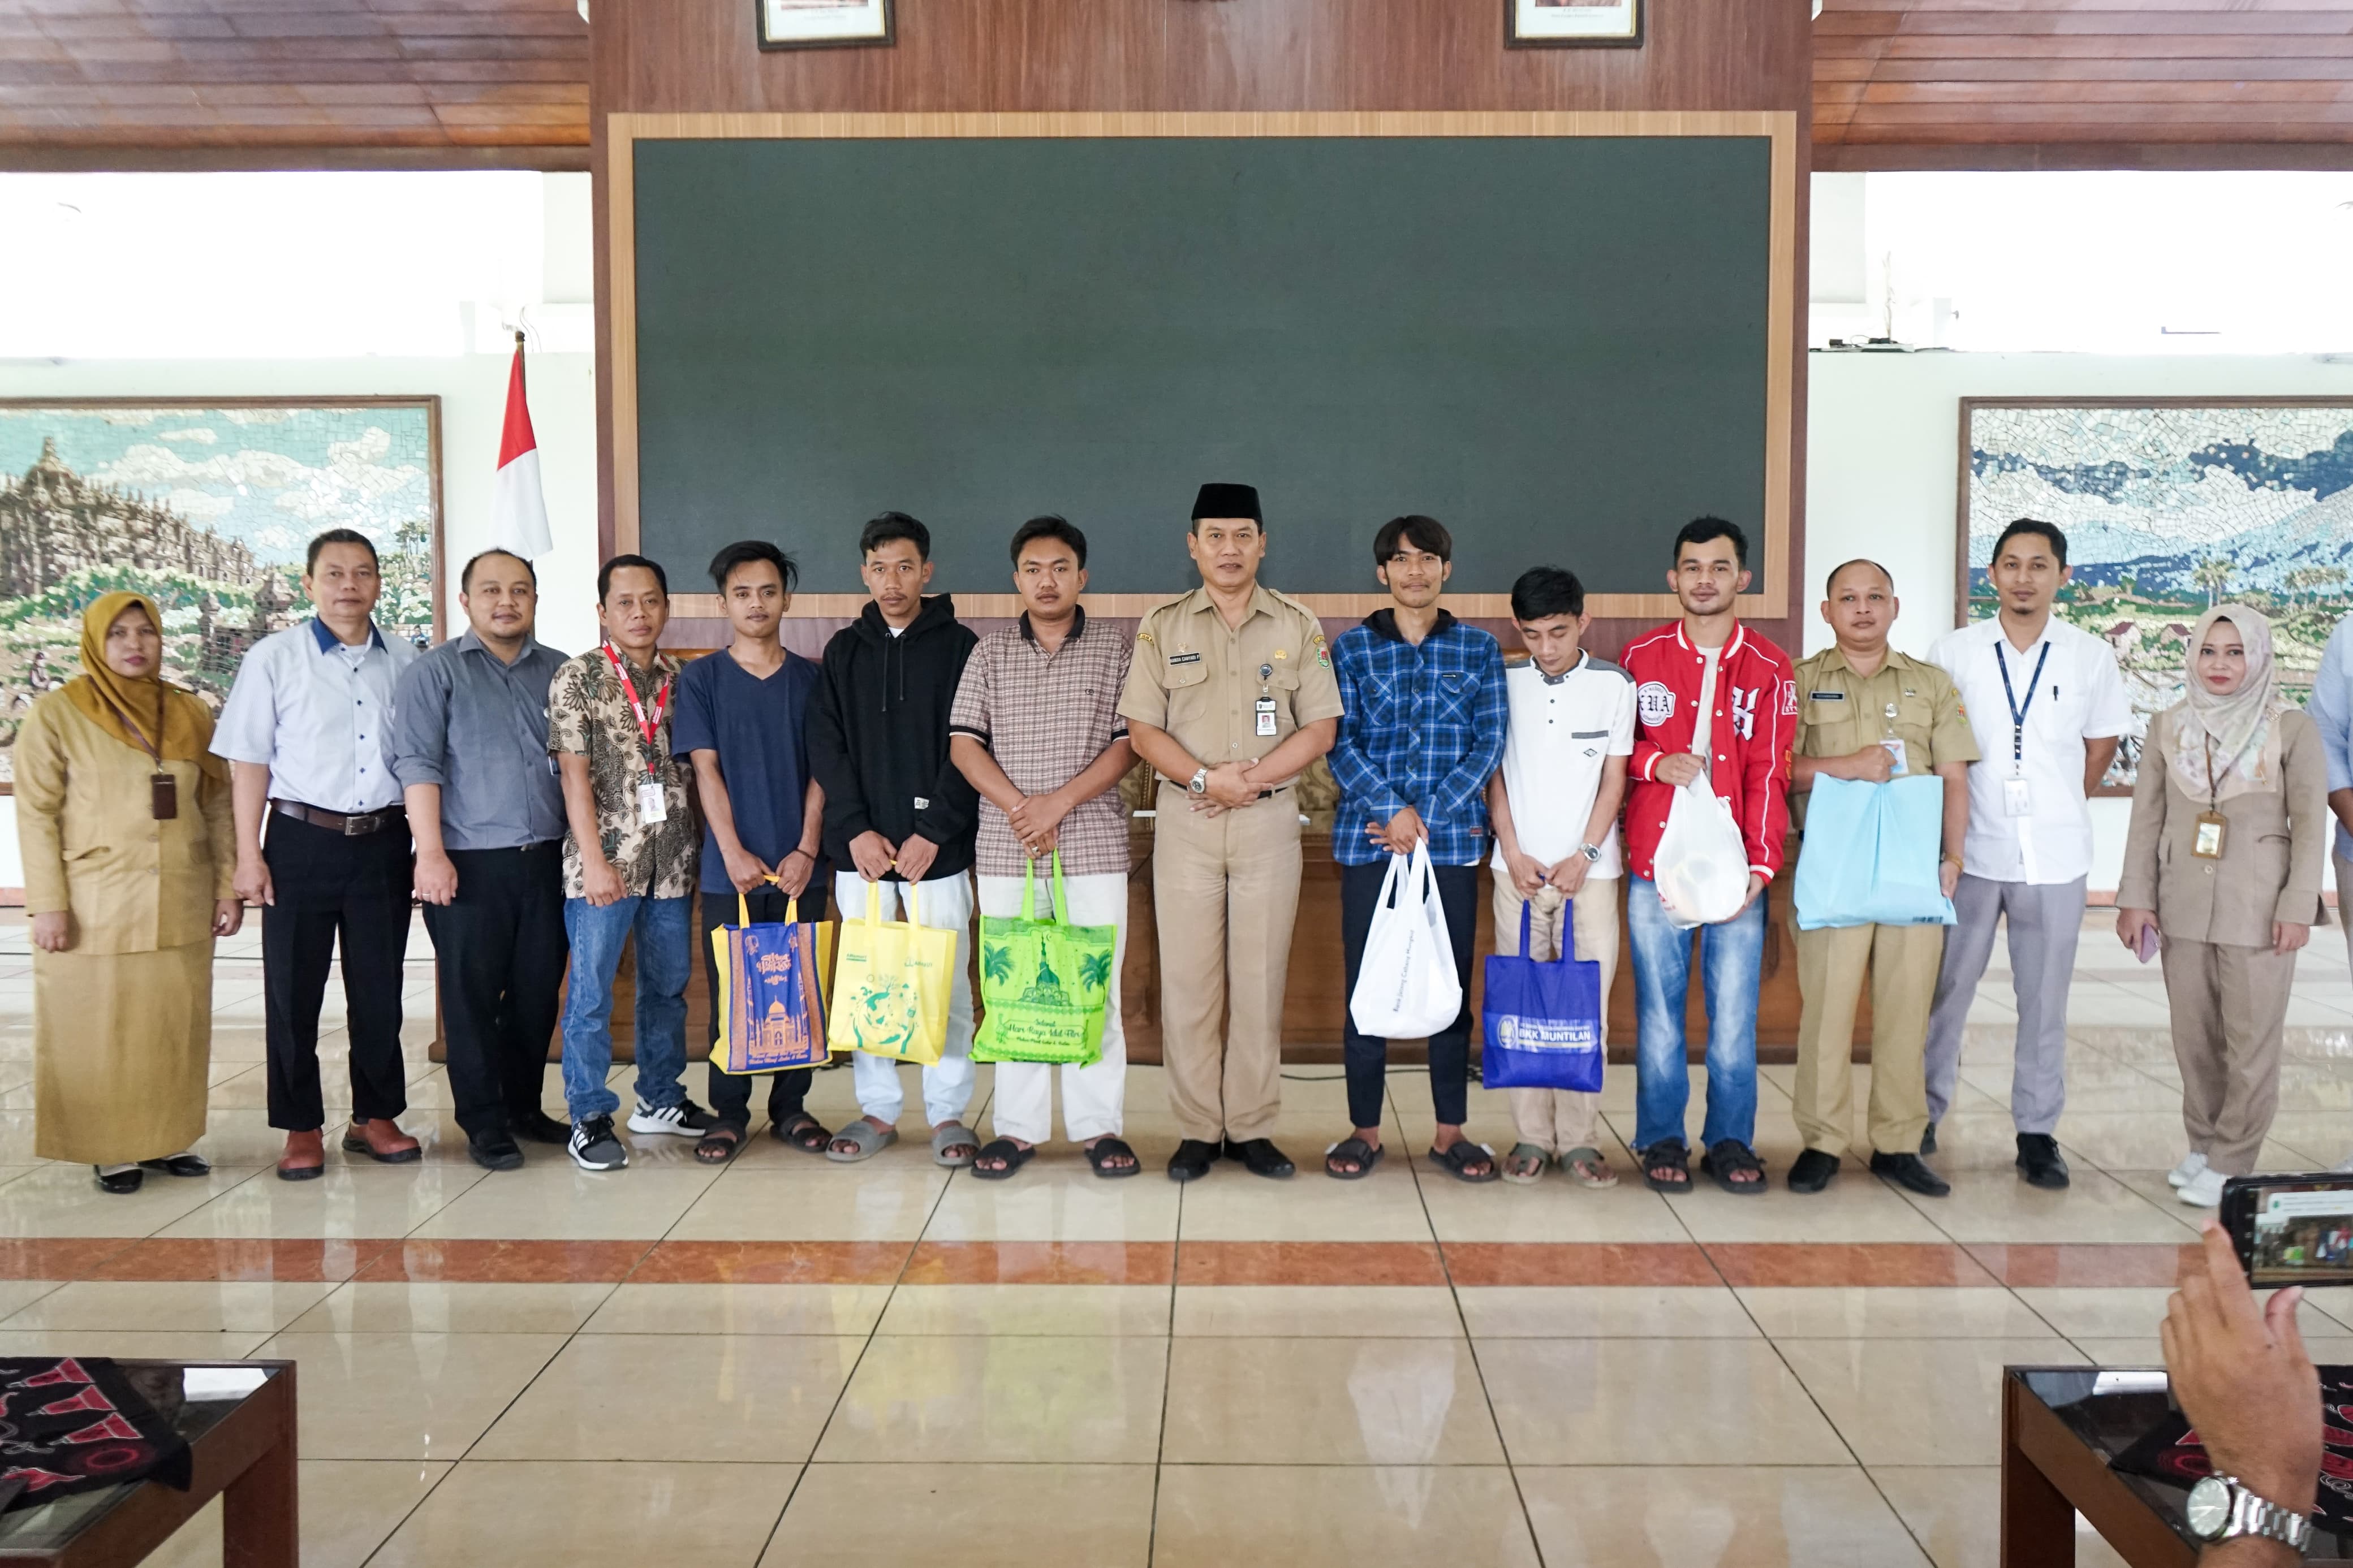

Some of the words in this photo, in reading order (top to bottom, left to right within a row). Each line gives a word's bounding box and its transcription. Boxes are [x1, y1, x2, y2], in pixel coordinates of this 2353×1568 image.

[1009, 1023, 1025, 1033] Hari
[1027, 1026, 1046, 1039] Raya
[1540, 1030, 1591, 1042] MUNTILAN
